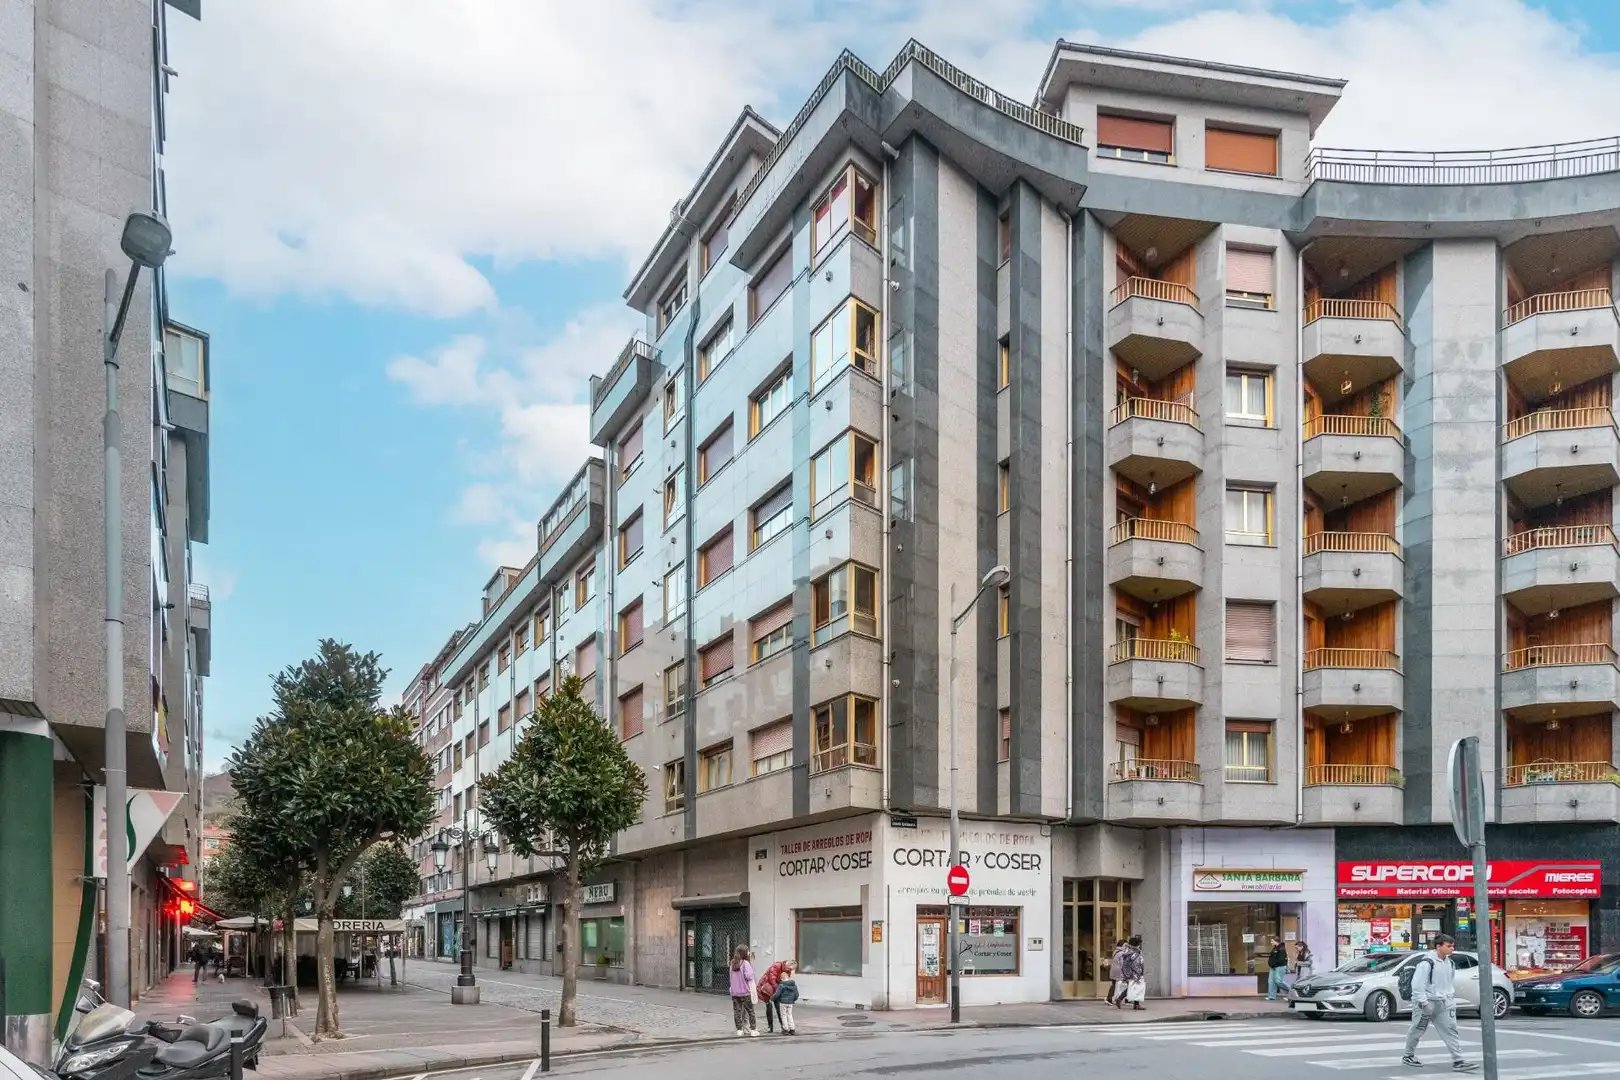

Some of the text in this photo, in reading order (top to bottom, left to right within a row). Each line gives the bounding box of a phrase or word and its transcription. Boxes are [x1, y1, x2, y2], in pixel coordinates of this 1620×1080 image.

[780, 843, 801, 855] TALLER
[803, 841, 811, 852] DE
[812, 836, 844, 850] ARREGLOS
[845, 834, 854, 845] DE
[984, 852, 1041, 870] COSER
[780, 857, 825, 877] CORTAR
[1222, 873, 1253, 882] SANTA
[1255, 873, 1301, 882] BARBARA
[1544, 872, 1594, 883] MIERES
[1552, 888, 1597, 896] Fotocopias
[333, 921, 386, 930] DRERIA
